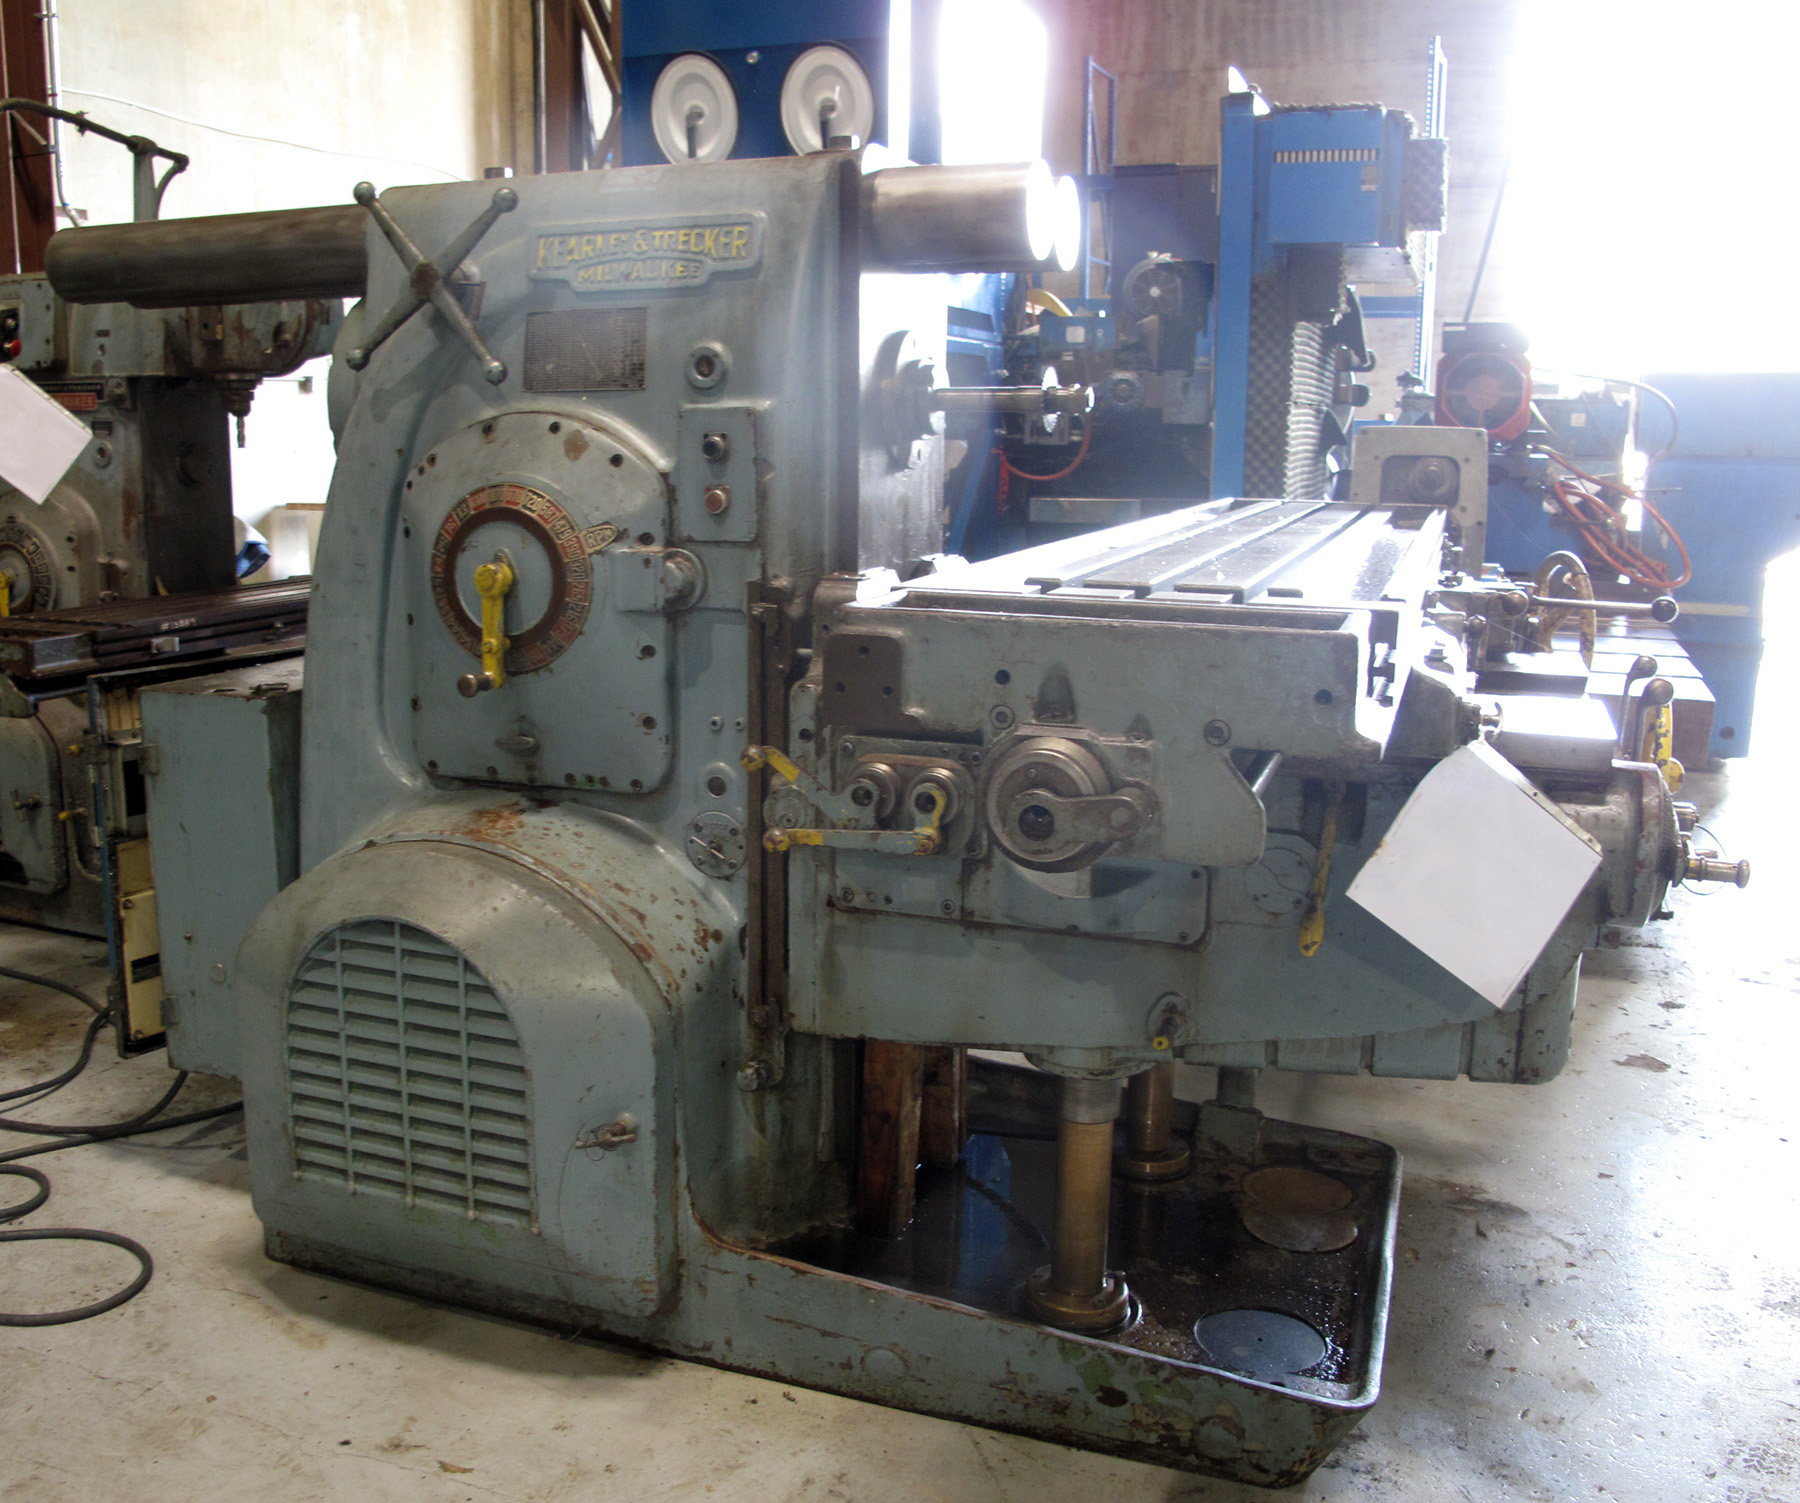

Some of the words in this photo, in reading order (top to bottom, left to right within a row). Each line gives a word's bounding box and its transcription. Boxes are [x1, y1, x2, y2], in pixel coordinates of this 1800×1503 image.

[651, 226, 749, 258] TRECKER
[525, 491, 543, 510] 720
[540, 502, 561, 522] 587
[553, 520, 573, 540] 479
[563, 537, 583, 559] 390
[570, 560, 585, 579] 320
[565, 602, 582, 621] 216
